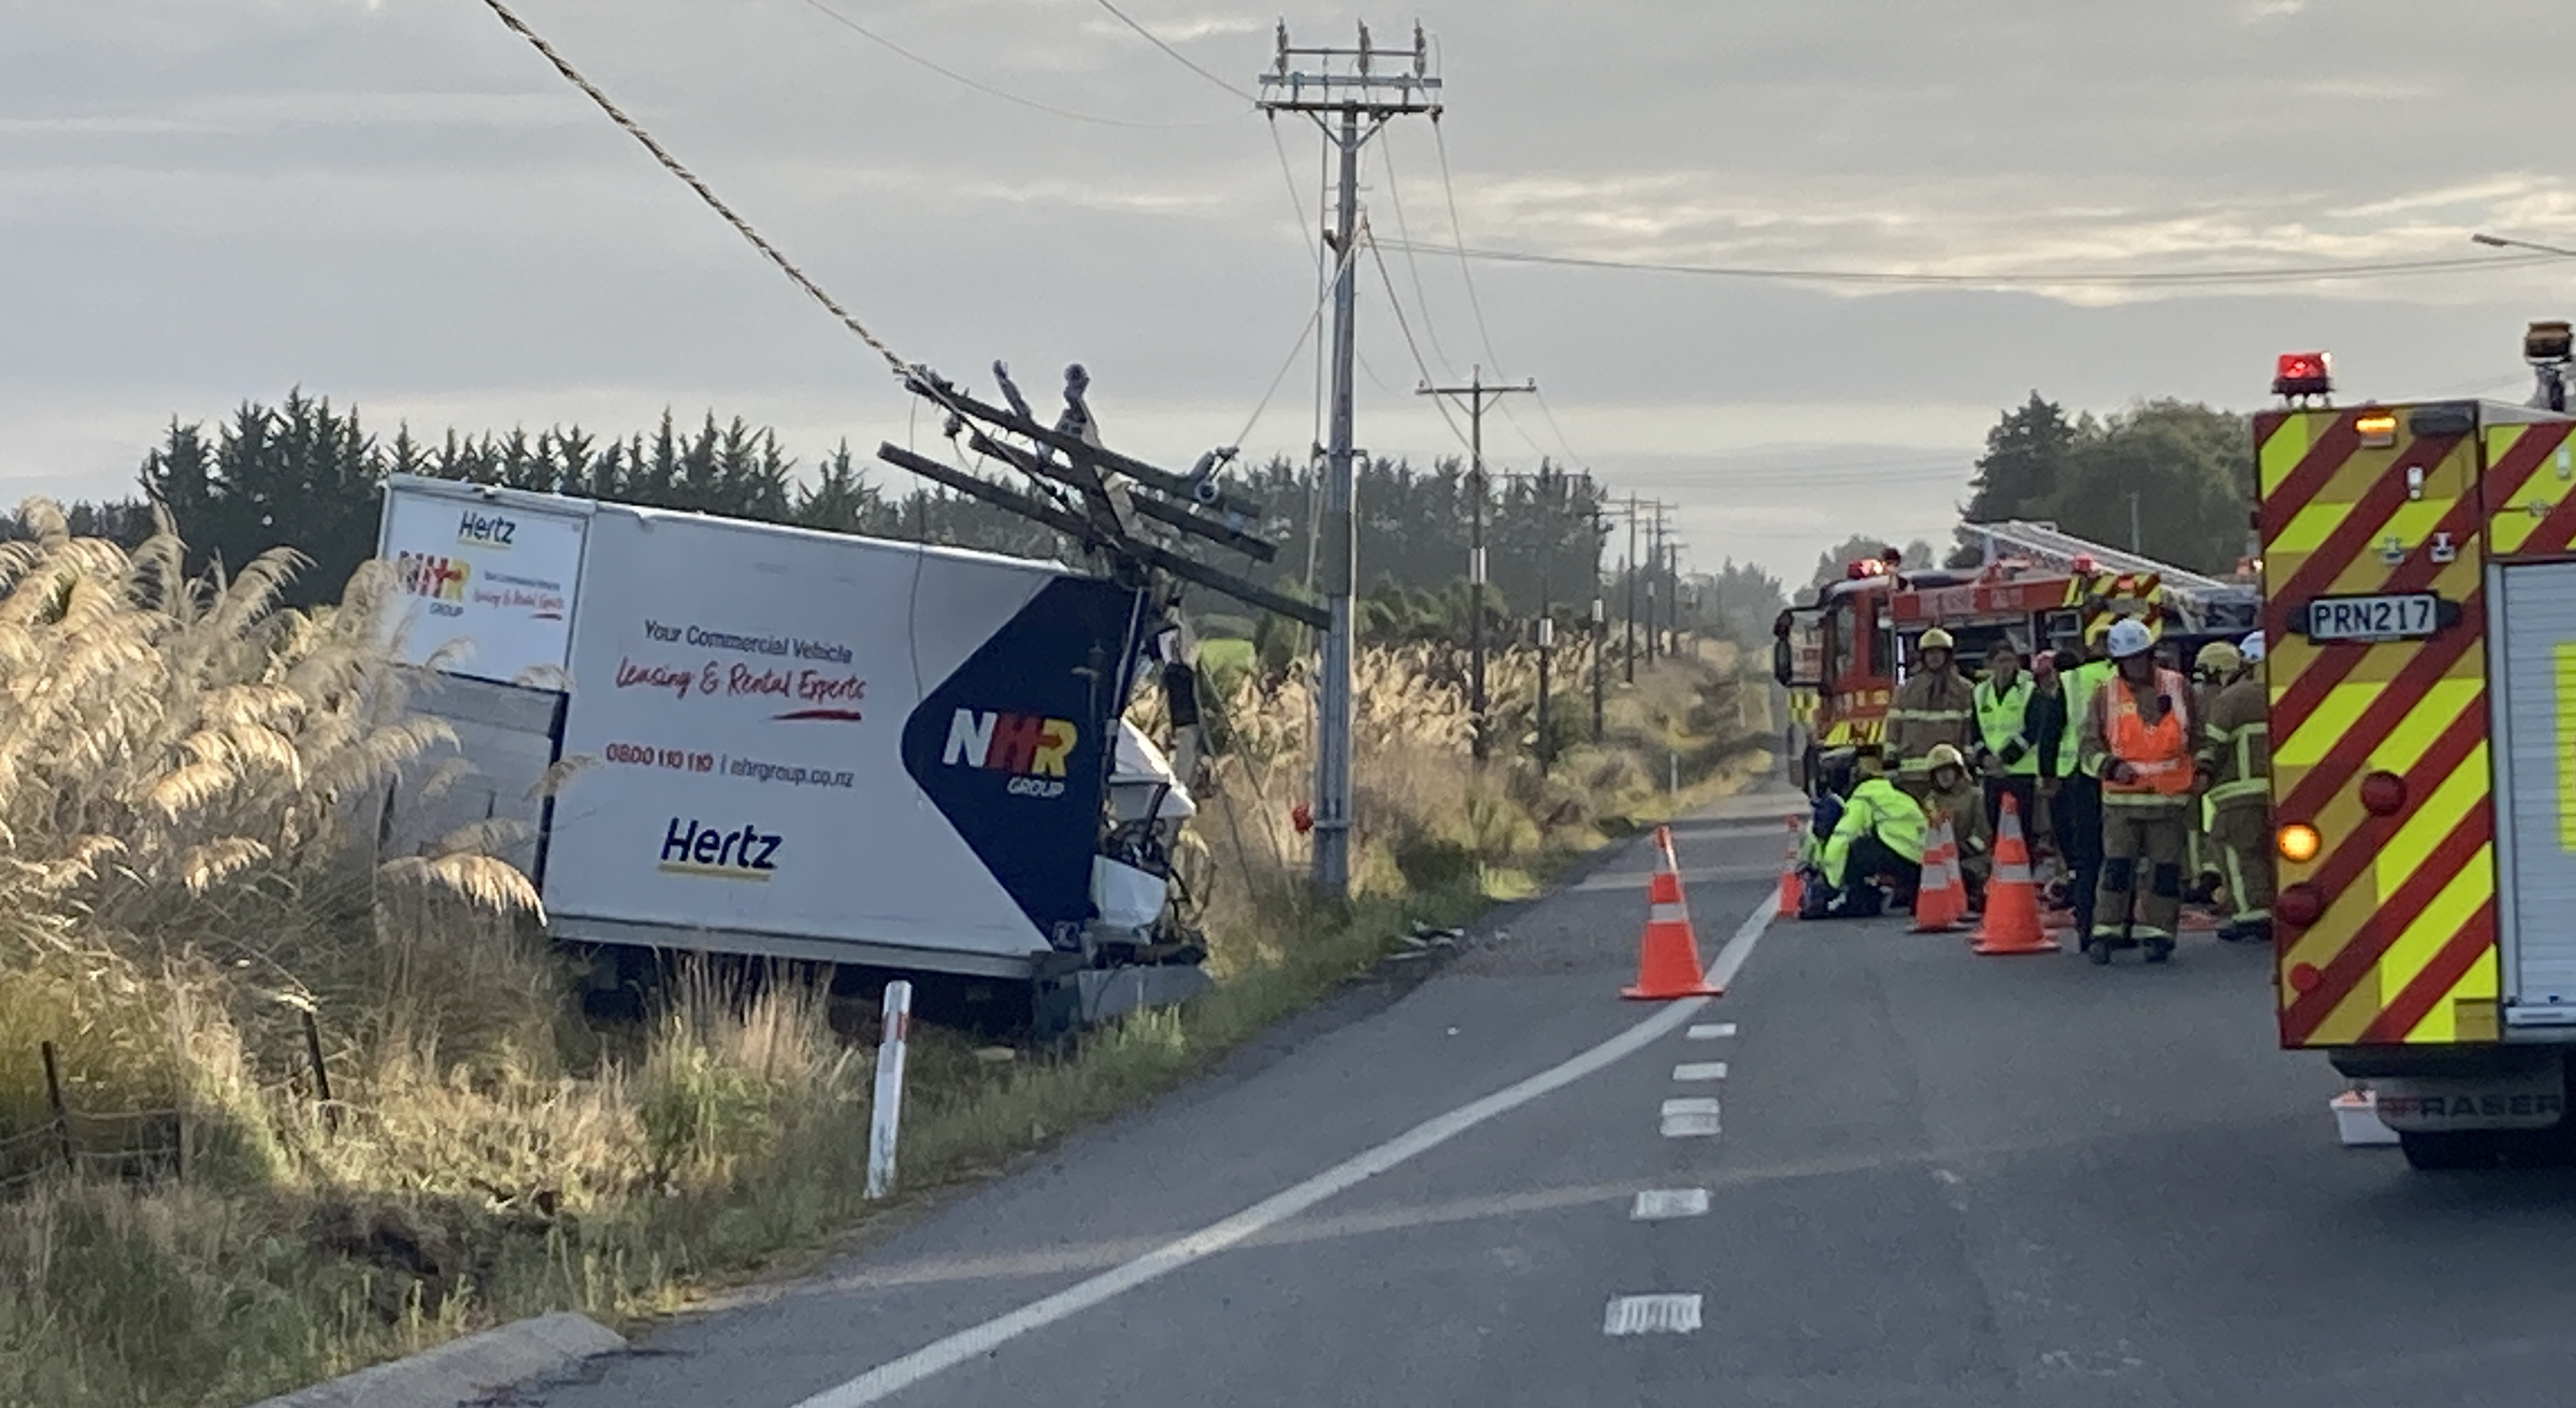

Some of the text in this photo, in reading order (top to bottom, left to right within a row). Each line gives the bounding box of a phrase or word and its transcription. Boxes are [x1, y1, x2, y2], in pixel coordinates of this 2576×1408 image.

[458, 509, 515, 544] Hertz
[429, 602, 464, 617] GROUP
[2314, 600, 2431, 634] PRN217
[645, 618, 854, 665] Your Commercial Vehicle
[616, 654, 867, 703] Leasing & Rental Experts
[941, 707, 1078, 777] NHR
[606, 743, 655, 766] 0800
[658, 748, 684, 770] 110
[730, 756, 856, 788] nhrgroup.co.nz
[1006, 776, 1065, 798] GROUP
[660, 816, 783, 870] Hertz
